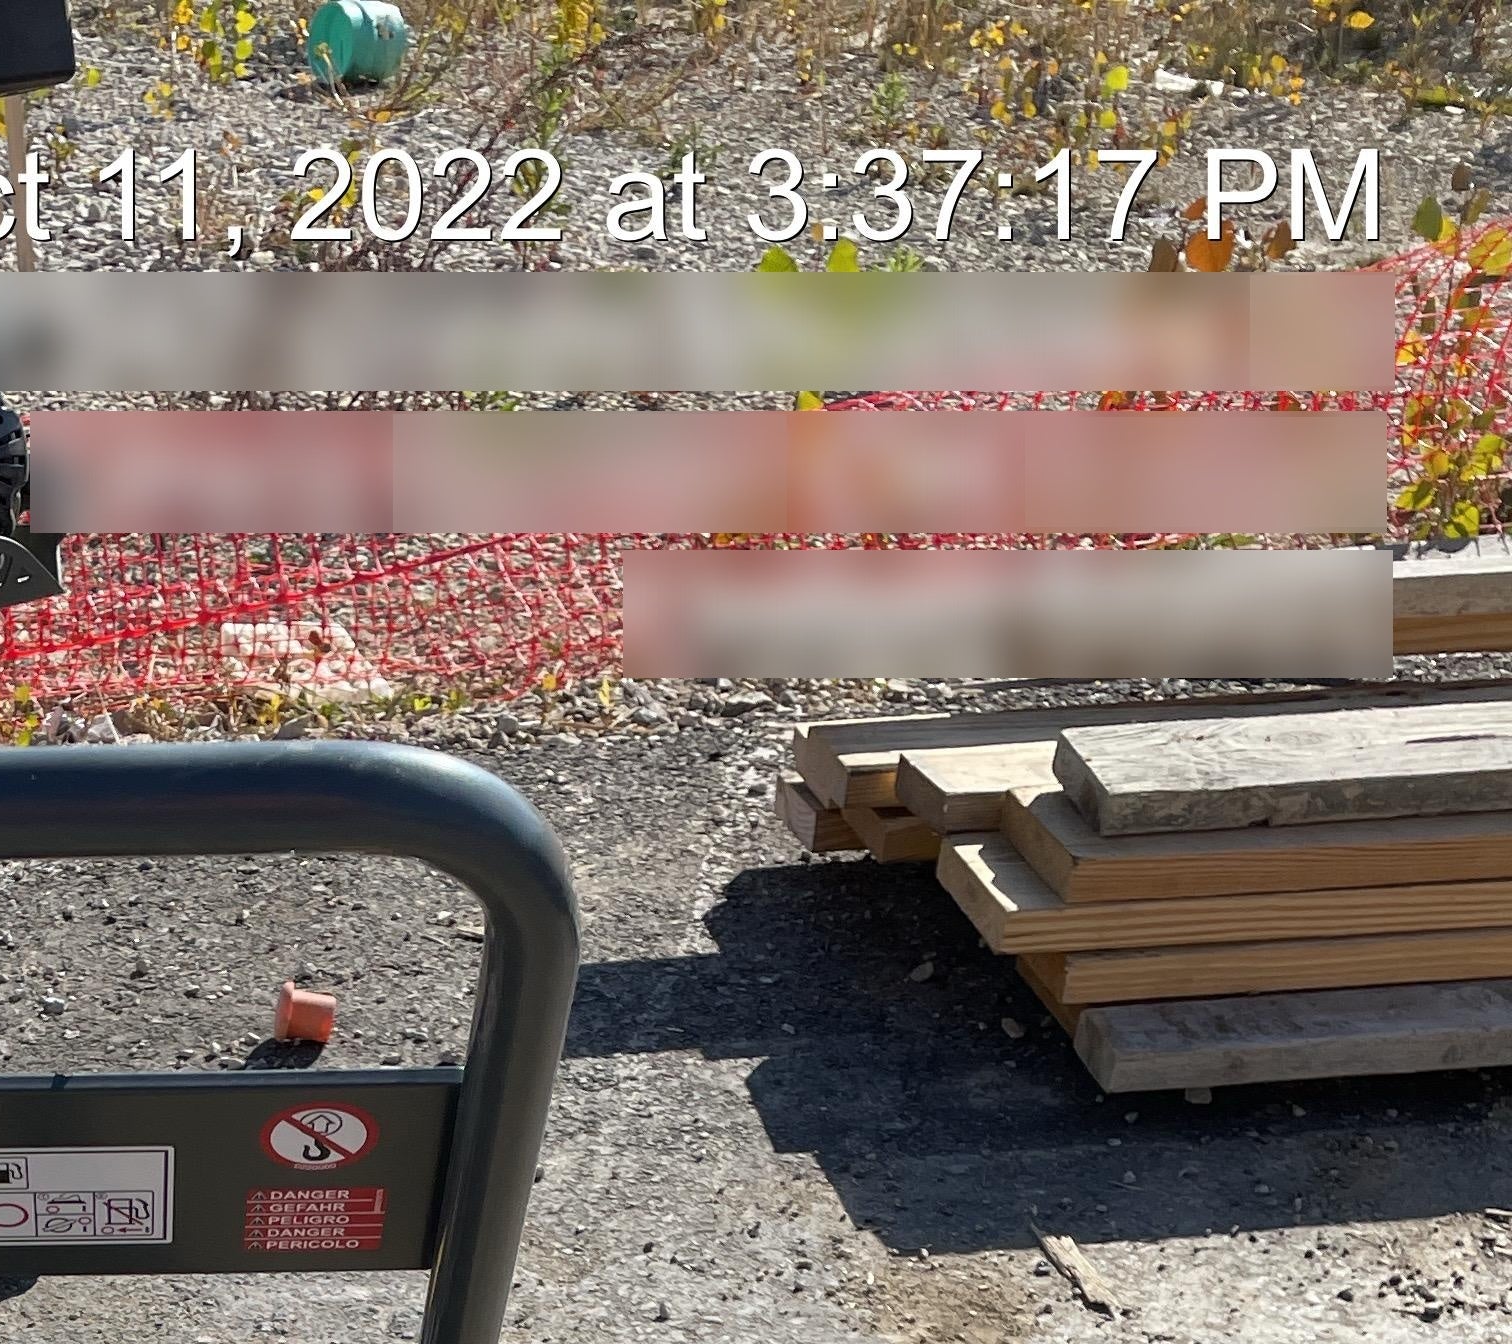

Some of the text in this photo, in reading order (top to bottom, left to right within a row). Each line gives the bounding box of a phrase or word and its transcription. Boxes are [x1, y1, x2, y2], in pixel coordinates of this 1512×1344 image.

[270, 1189, 350, 1200] DANGER
[269, 1203, 345, 1213] GEFAHR
[268, 1215, 350, 1225] PELIGRO
[268, 1228, 345, 1238] DANGER
[266, 1239, 360, 1250] PERICOLO
